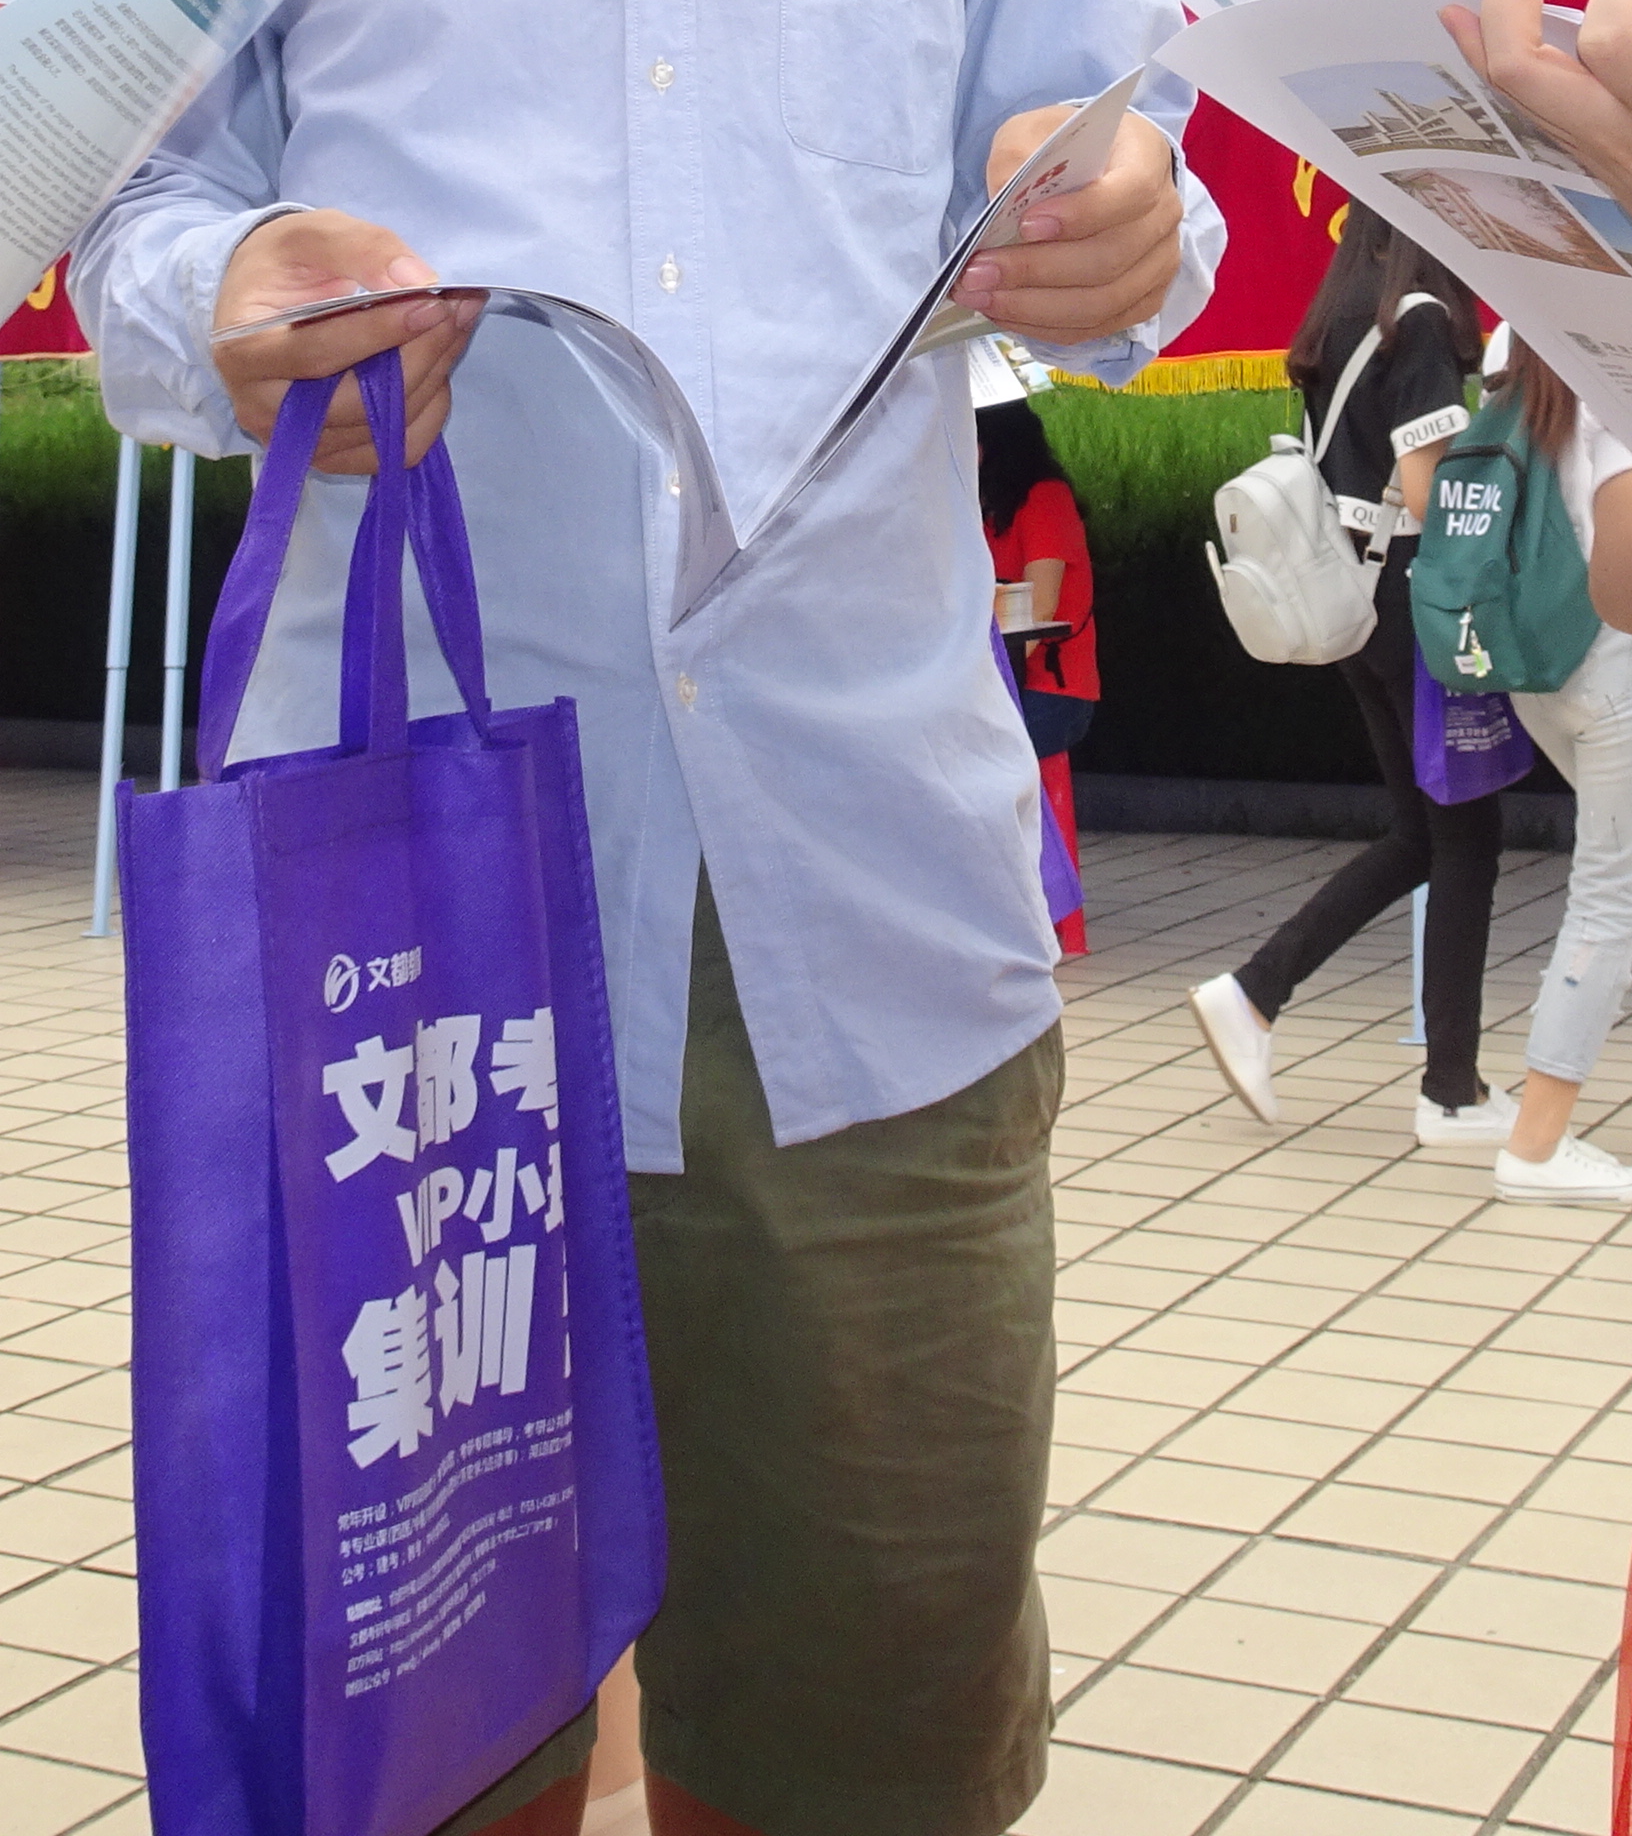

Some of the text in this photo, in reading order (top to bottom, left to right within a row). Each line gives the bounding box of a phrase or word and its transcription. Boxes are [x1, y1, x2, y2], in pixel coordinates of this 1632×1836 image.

[1402, 413, 1456, 448] QUIET
[1446, 514, 1491, 536] HUO
[396, 1141, 564, 1267] VIP小
